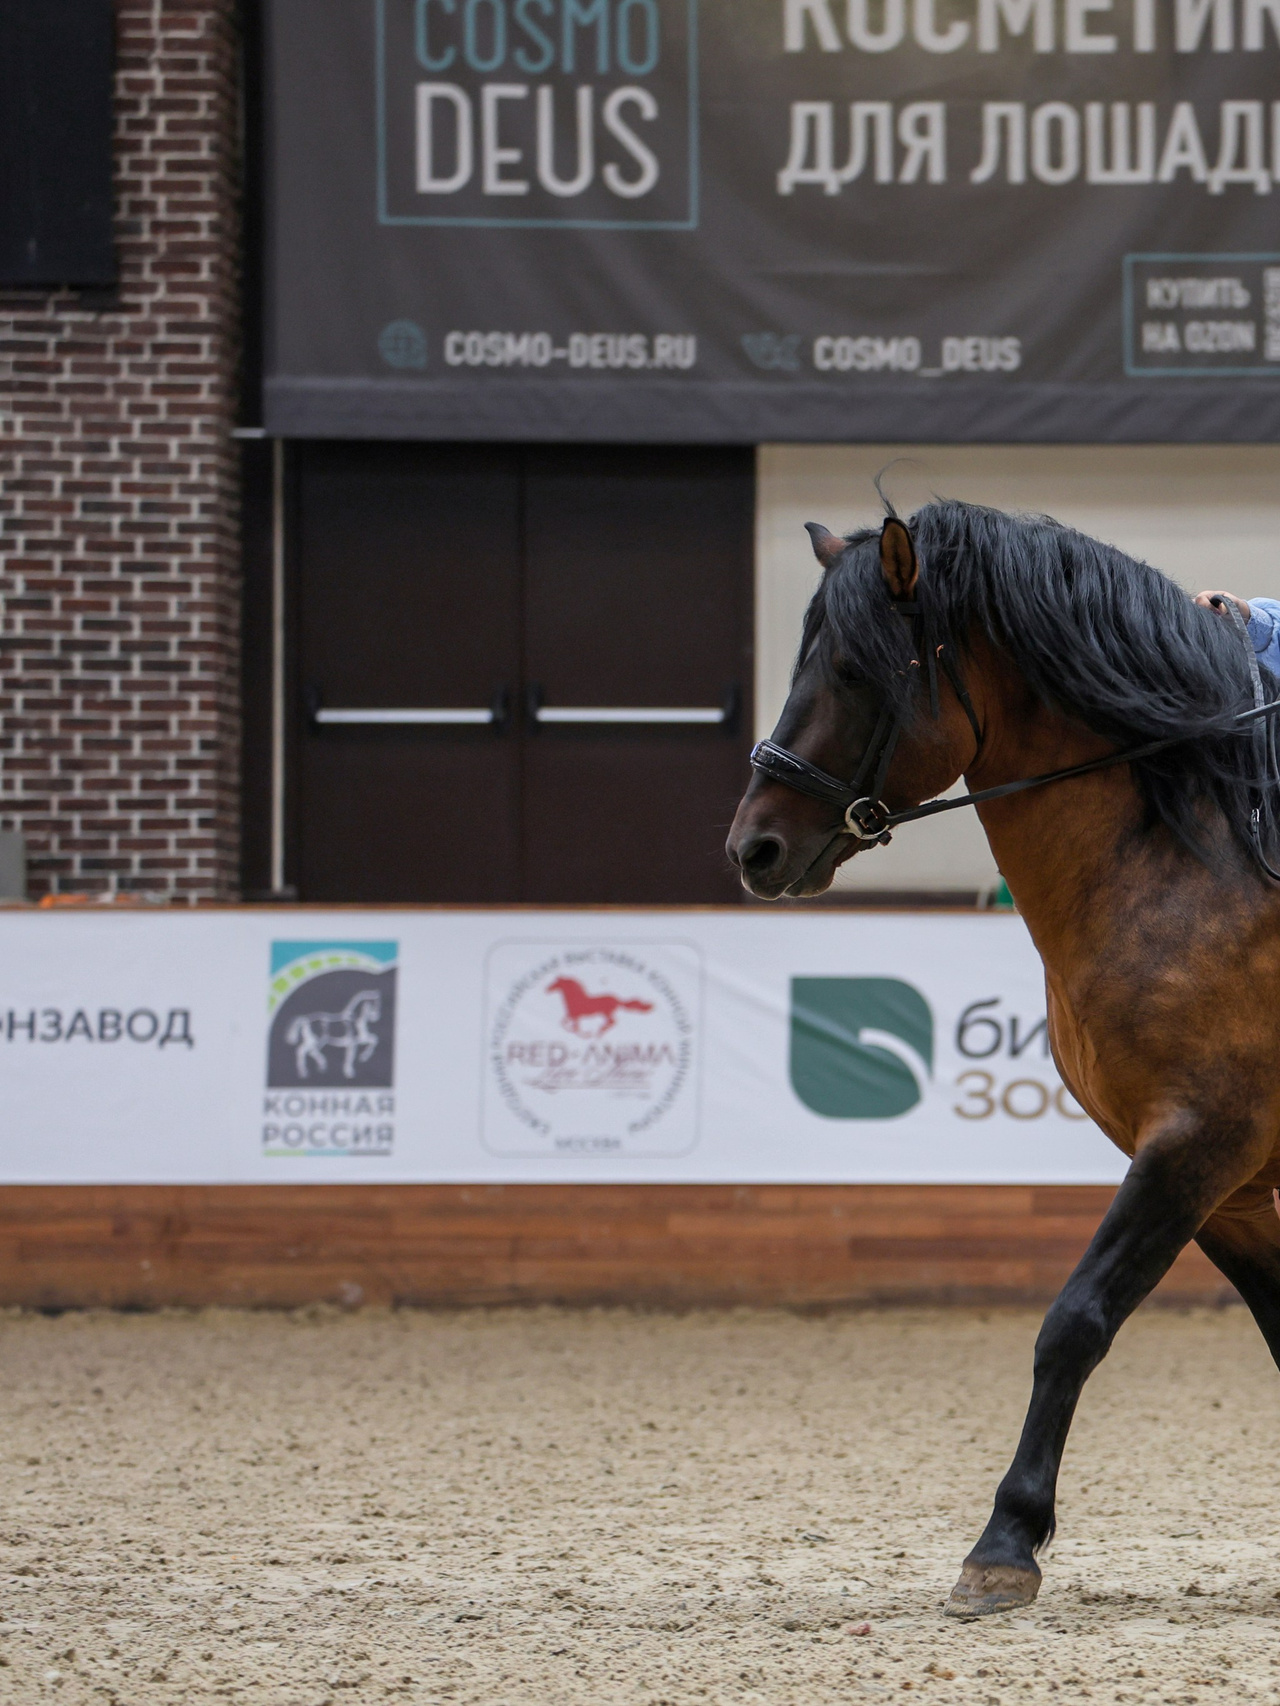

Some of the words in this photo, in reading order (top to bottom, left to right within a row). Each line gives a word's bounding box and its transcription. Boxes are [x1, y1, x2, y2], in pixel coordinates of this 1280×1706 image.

[415, 0, 659, 75] COSMO
[415, 81, 660, 199] DEUS
[777, 101, 946, 196] ДЛЯ
[1146, 277, 1251, 310] КУПИТЬ
[444, 330, 697, 369] COSMO-DEUS.RU
[813, 336, 1022, 377] COSMO_DEUS
[1142, 321, 1181, 353] НА
[0, 1008, 195, 1049] НЗАВОД
[263, 1095, 395, 1118] КОННАЯ
[262, 1122, 395, 1148] РОССИЯ
